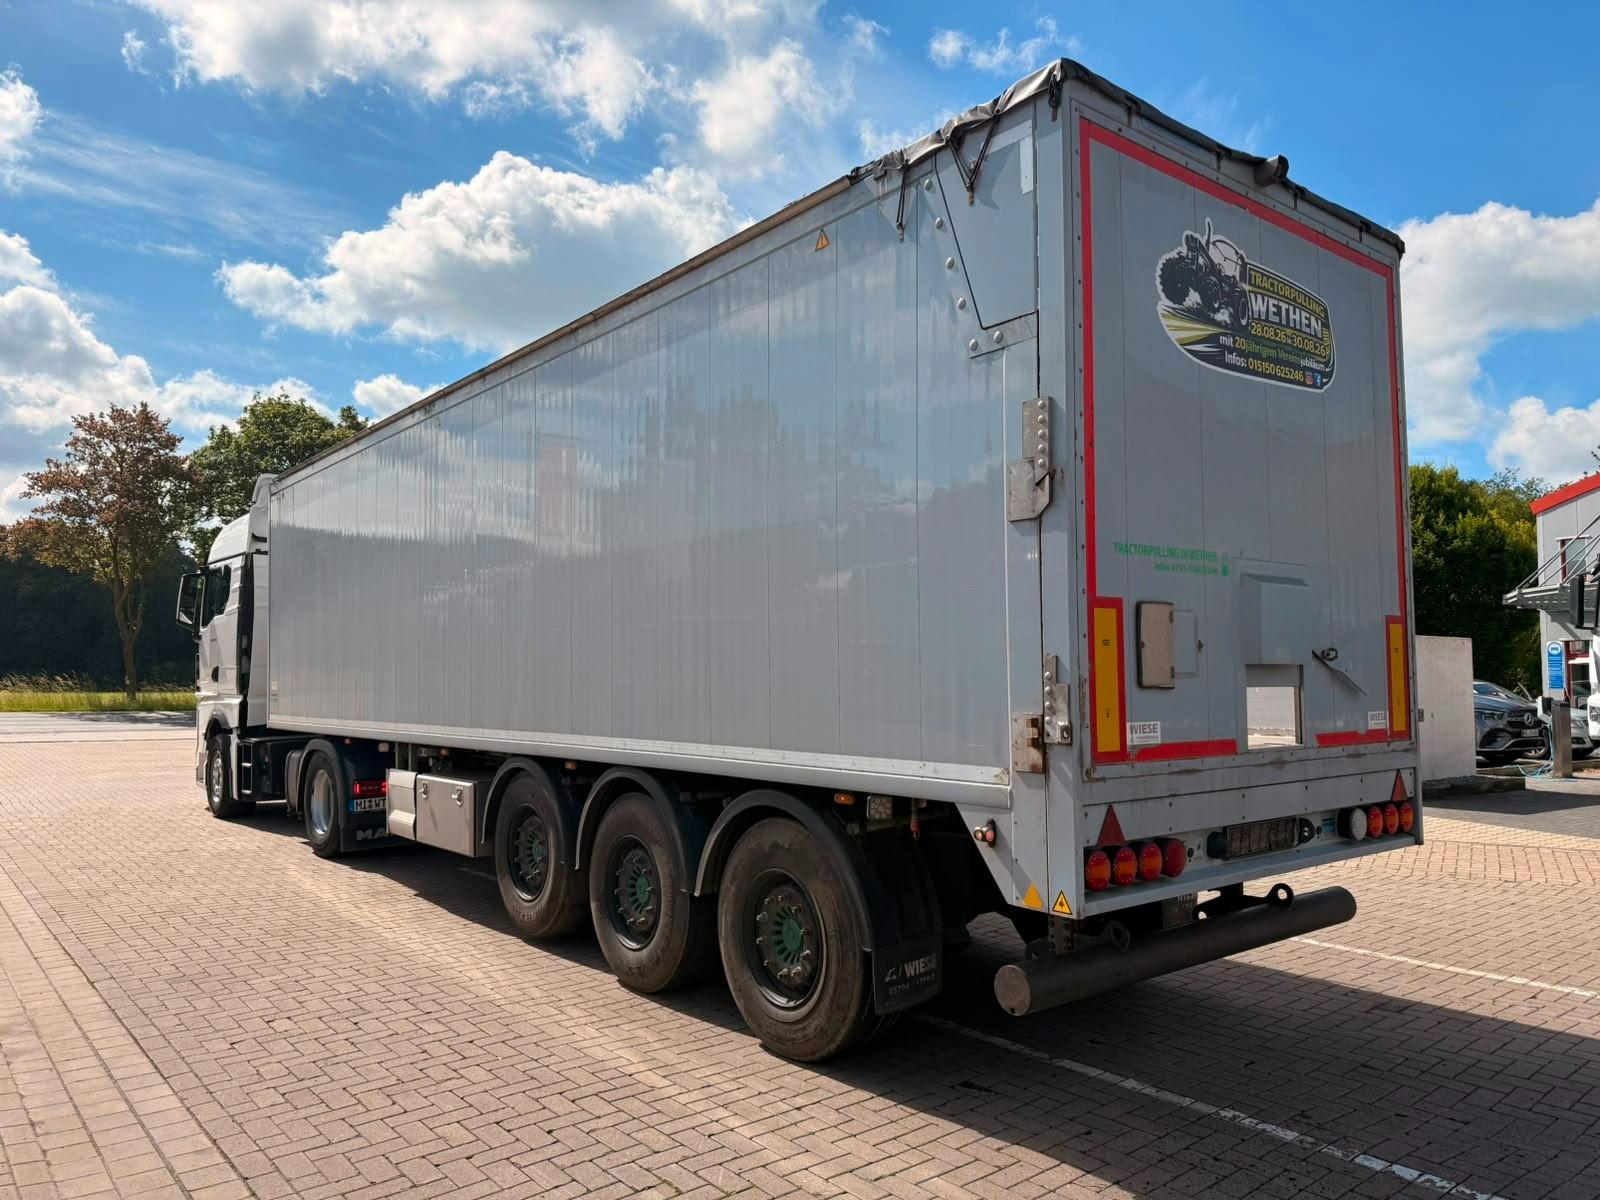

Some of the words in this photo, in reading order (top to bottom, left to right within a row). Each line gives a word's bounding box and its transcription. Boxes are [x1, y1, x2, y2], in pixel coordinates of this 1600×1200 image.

[1250, 271, 1325, 317] TRACTORPULLING
[1250, 292, 1323, 339] WETHEN
[1219, 335, 1234, 348] mit
[1250, 323, 1287, 344] 28.08.26
[1292, 334, 1327, 357] 30.08.26
[1224, 350, 1247, 368] Infos:
[1129, 723, 1159, 735] WIESE
[356, 828, 387, 840] MA
